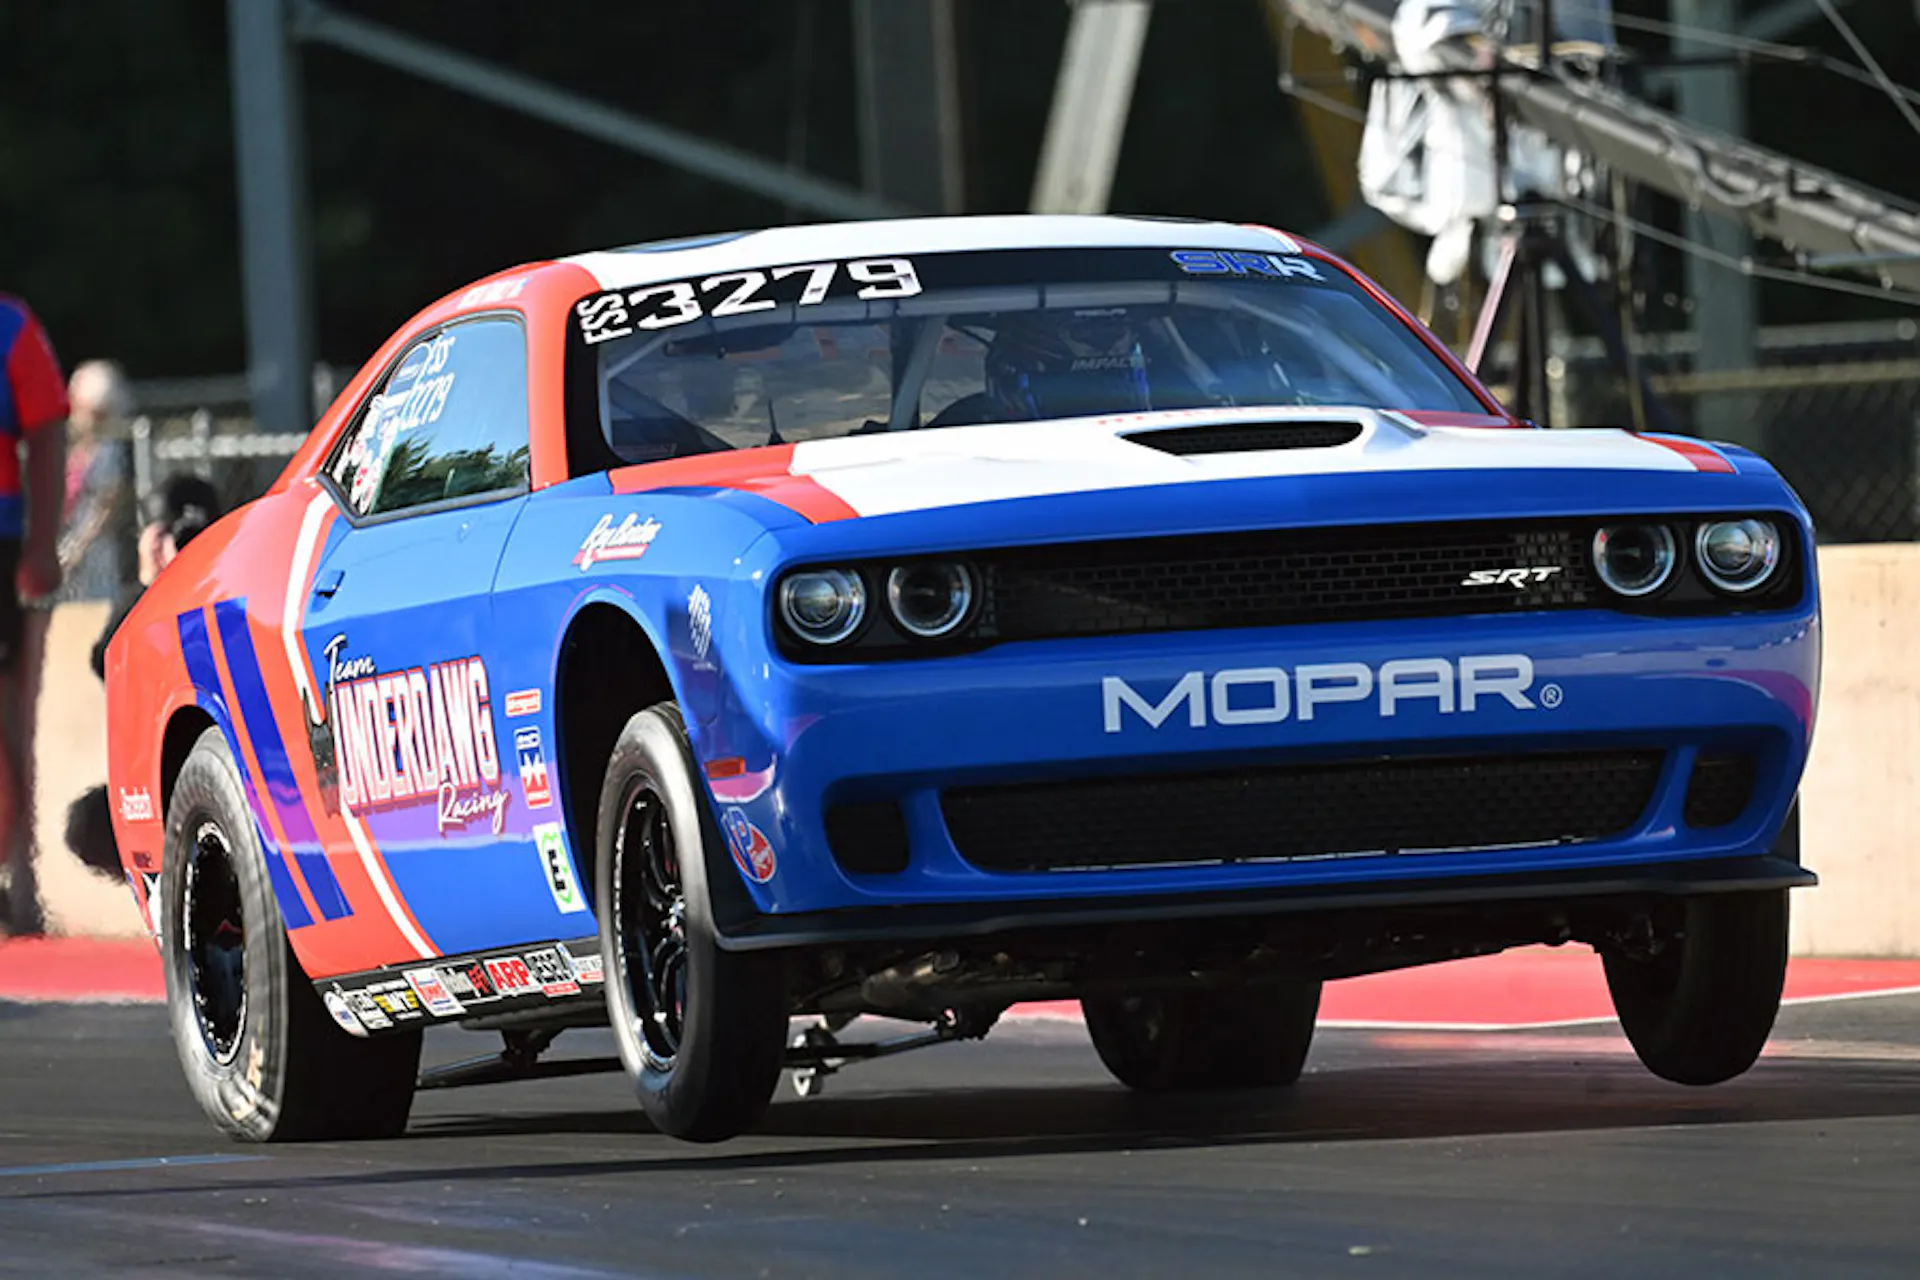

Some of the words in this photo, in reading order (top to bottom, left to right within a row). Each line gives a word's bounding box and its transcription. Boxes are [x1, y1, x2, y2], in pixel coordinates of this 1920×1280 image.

[628, 259, 922, 330] 3279
[1461, 566, 1562, 588] SRT
[324, 633, 376, 692] Team
[333, 655, 501, 808] UNDERDAWG
[438, 782, 509, 835] Racing
[487, 959, 529, 991] ARP
